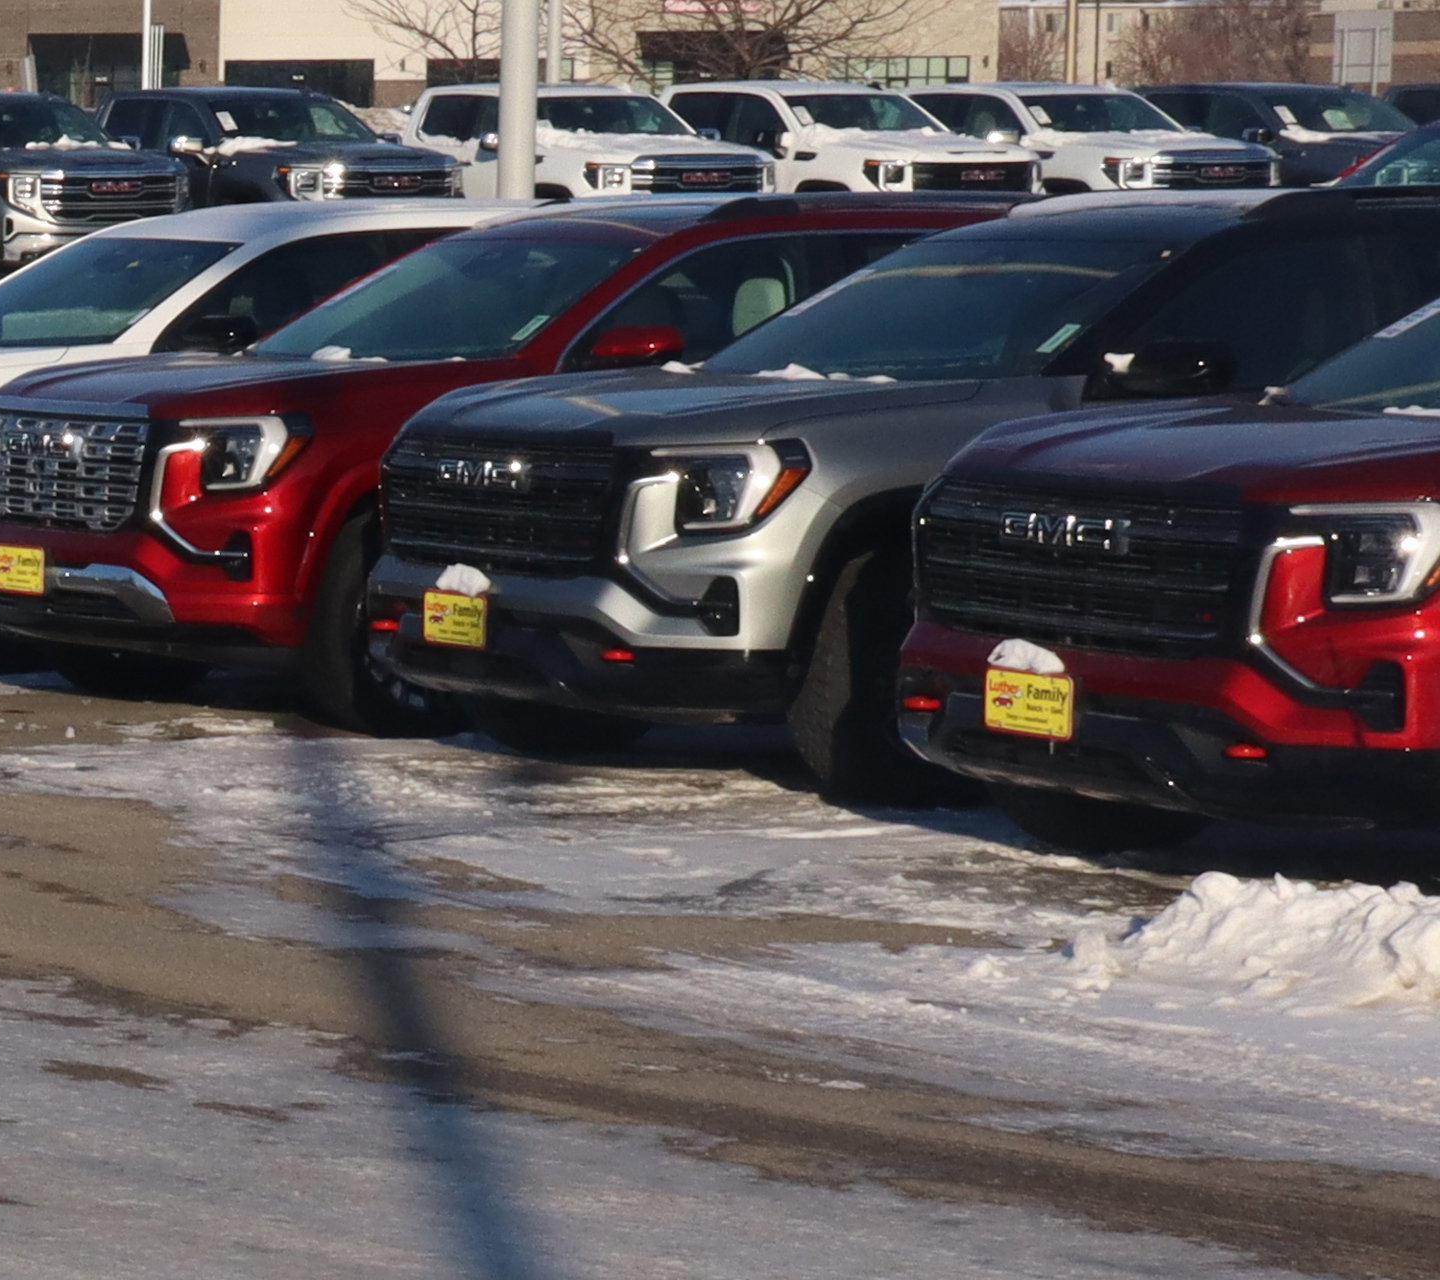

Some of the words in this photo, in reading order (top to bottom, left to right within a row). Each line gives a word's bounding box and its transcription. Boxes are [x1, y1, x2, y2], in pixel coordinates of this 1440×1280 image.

[437, 458, 518, 489] GMC
[1000, 511, 1113, 550] GMC
[989, 678, 1020, 694] Luther
[1026, 683, 1068, 707] Family
